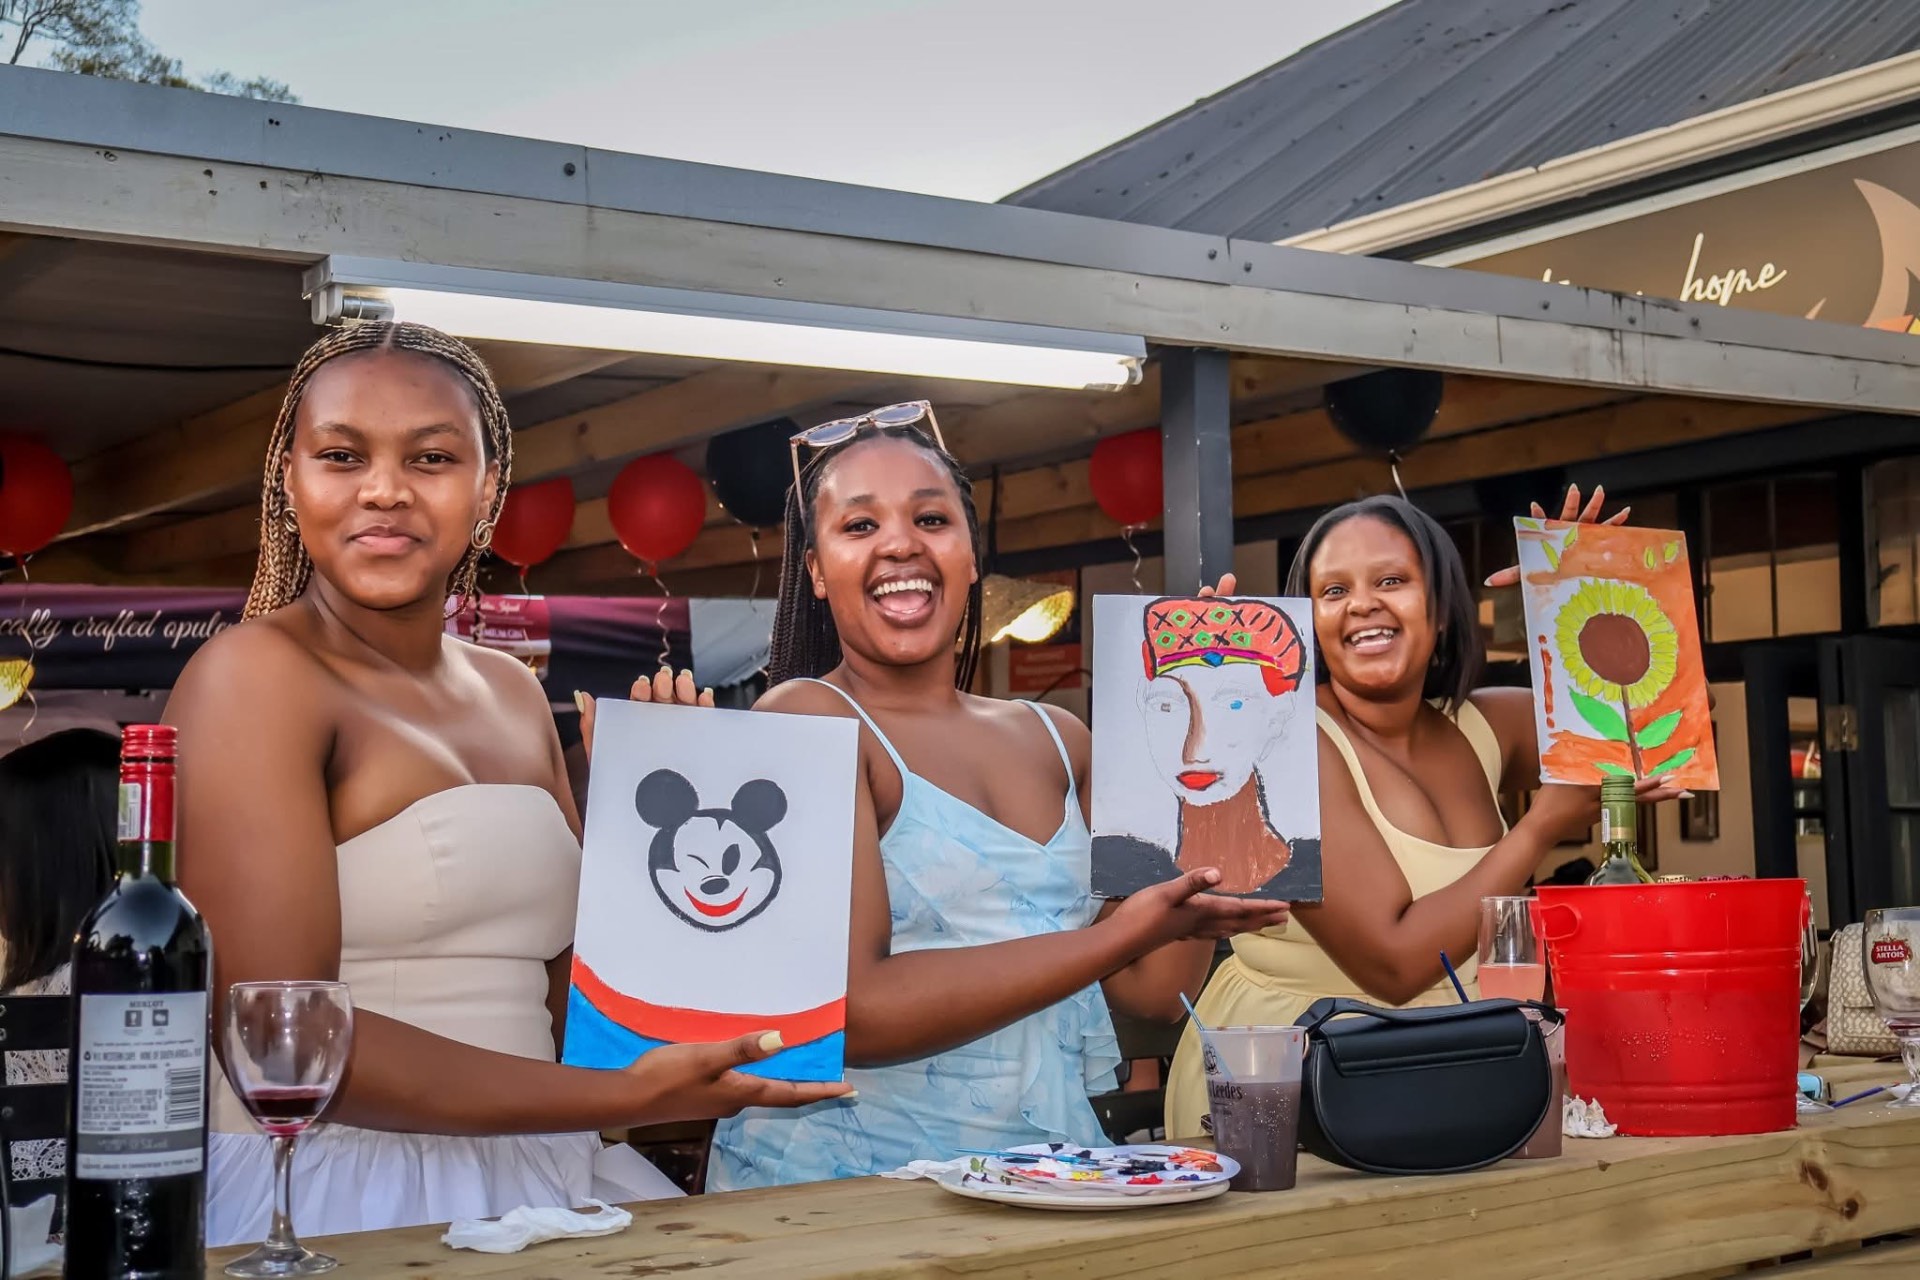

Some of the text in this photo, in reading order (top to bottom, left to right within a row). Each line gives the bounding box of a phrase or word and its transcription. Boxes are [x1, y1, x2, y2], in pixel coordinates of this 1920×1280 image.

[1680, 232, 1787, 306] home
[72, 609, 163, 651] crafted
[1876, 951, 1905, 959] ARTOIS
[129, 1000, 164, 1008] MERLOT
